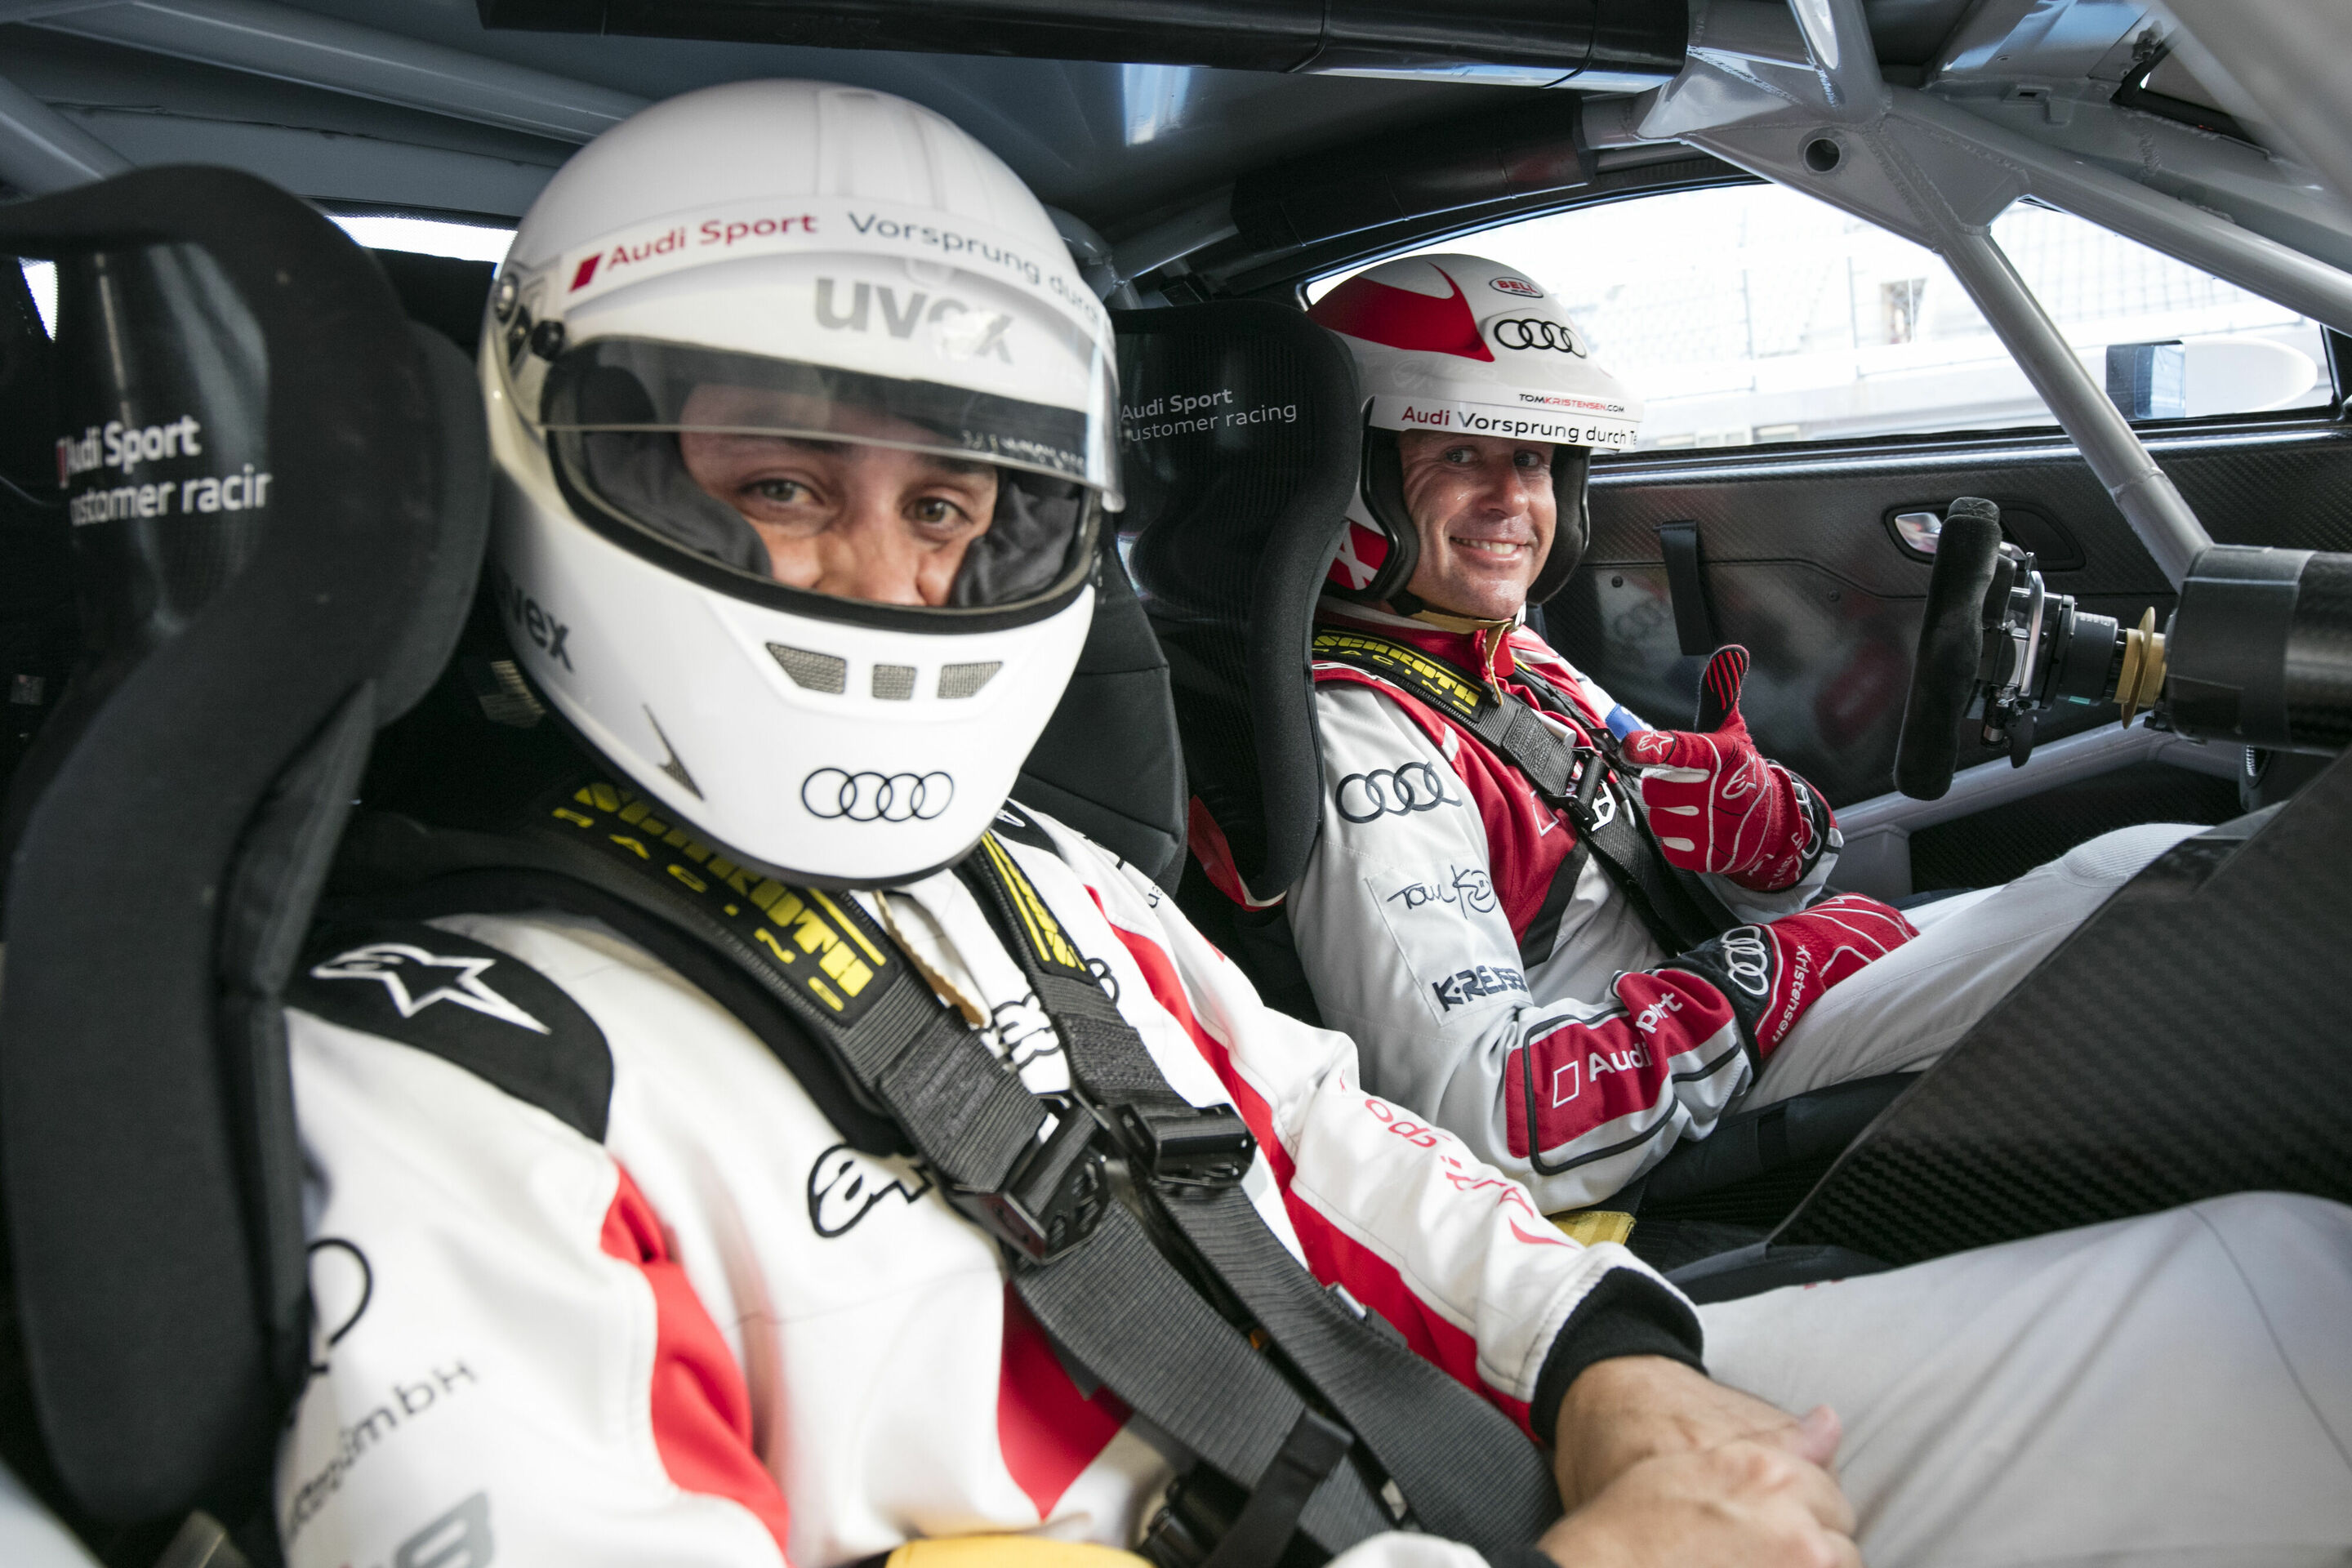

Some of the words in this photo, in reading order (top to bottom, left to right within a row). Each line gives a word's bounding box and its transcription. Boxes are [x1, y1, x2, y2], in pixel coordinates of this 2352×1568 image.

[606, 227, 686, 271] Audi
[700, 214, 819, 246] Sport
[848, 212, 1041, 286] Vorsprung
[1049, 273, 1099, 323] durc
[1496, 279, 1539, 294] BELL
[1120, 397, 1165, 421] Audi
[1169, 389, 1233, 415] Sport
[1129, 416, 1218, 443] ustomer
[1225, 403, 1298, 428] racing
[1401, 406, 1450, 426] Audi
[1457, 411, 1580, 443] Vorsprung
[1586, 425, 1627, 445] durch
[102, 413, 203, 475] Sport
[69, 481, 176, 527] ustomer
[1588, 1040, 1652, 1083] Audi
[1635, 991, 1684, 1035] prt
